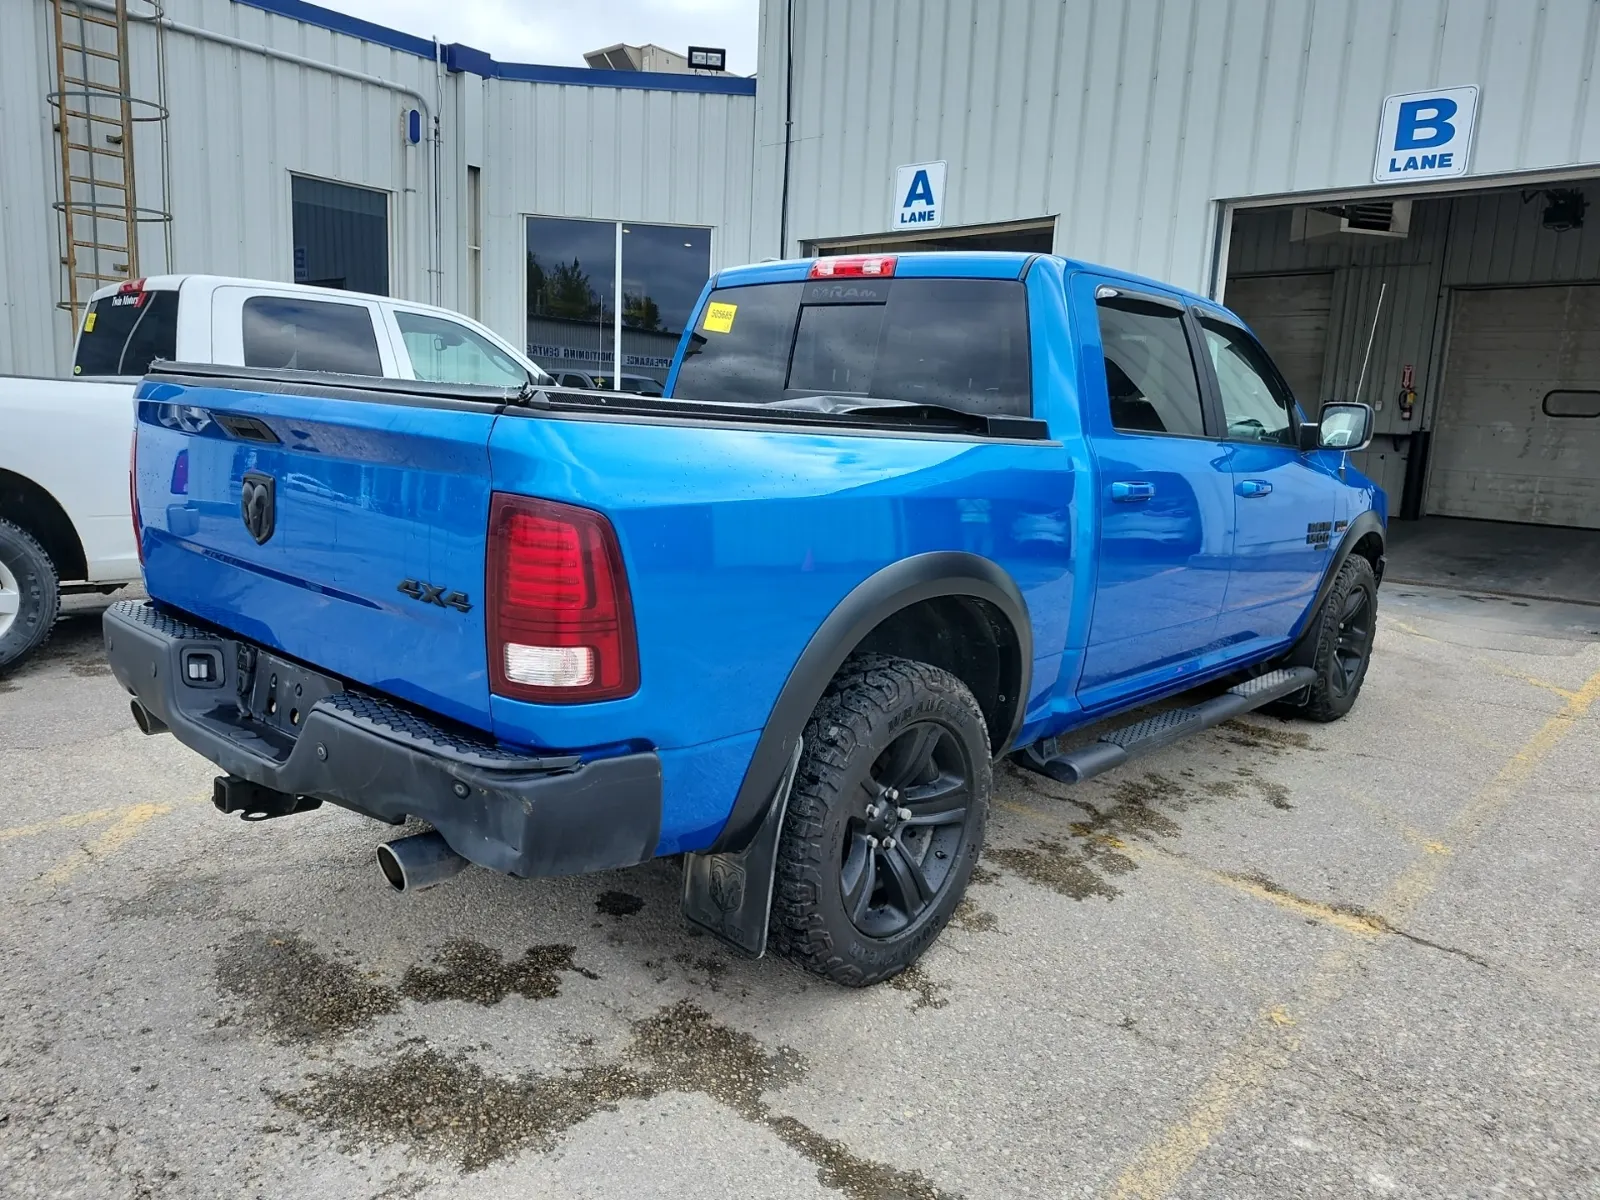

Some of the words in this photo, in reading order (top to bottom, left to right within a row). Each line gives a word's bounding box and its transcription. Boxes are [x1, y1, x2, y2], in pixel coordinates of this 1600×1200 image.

[1394, 98, 1457, 151] B
[1389, 153, 1453, 172] LANE
[903, 169, 934, 207] A
[900, 210, 935, 223] LANE
